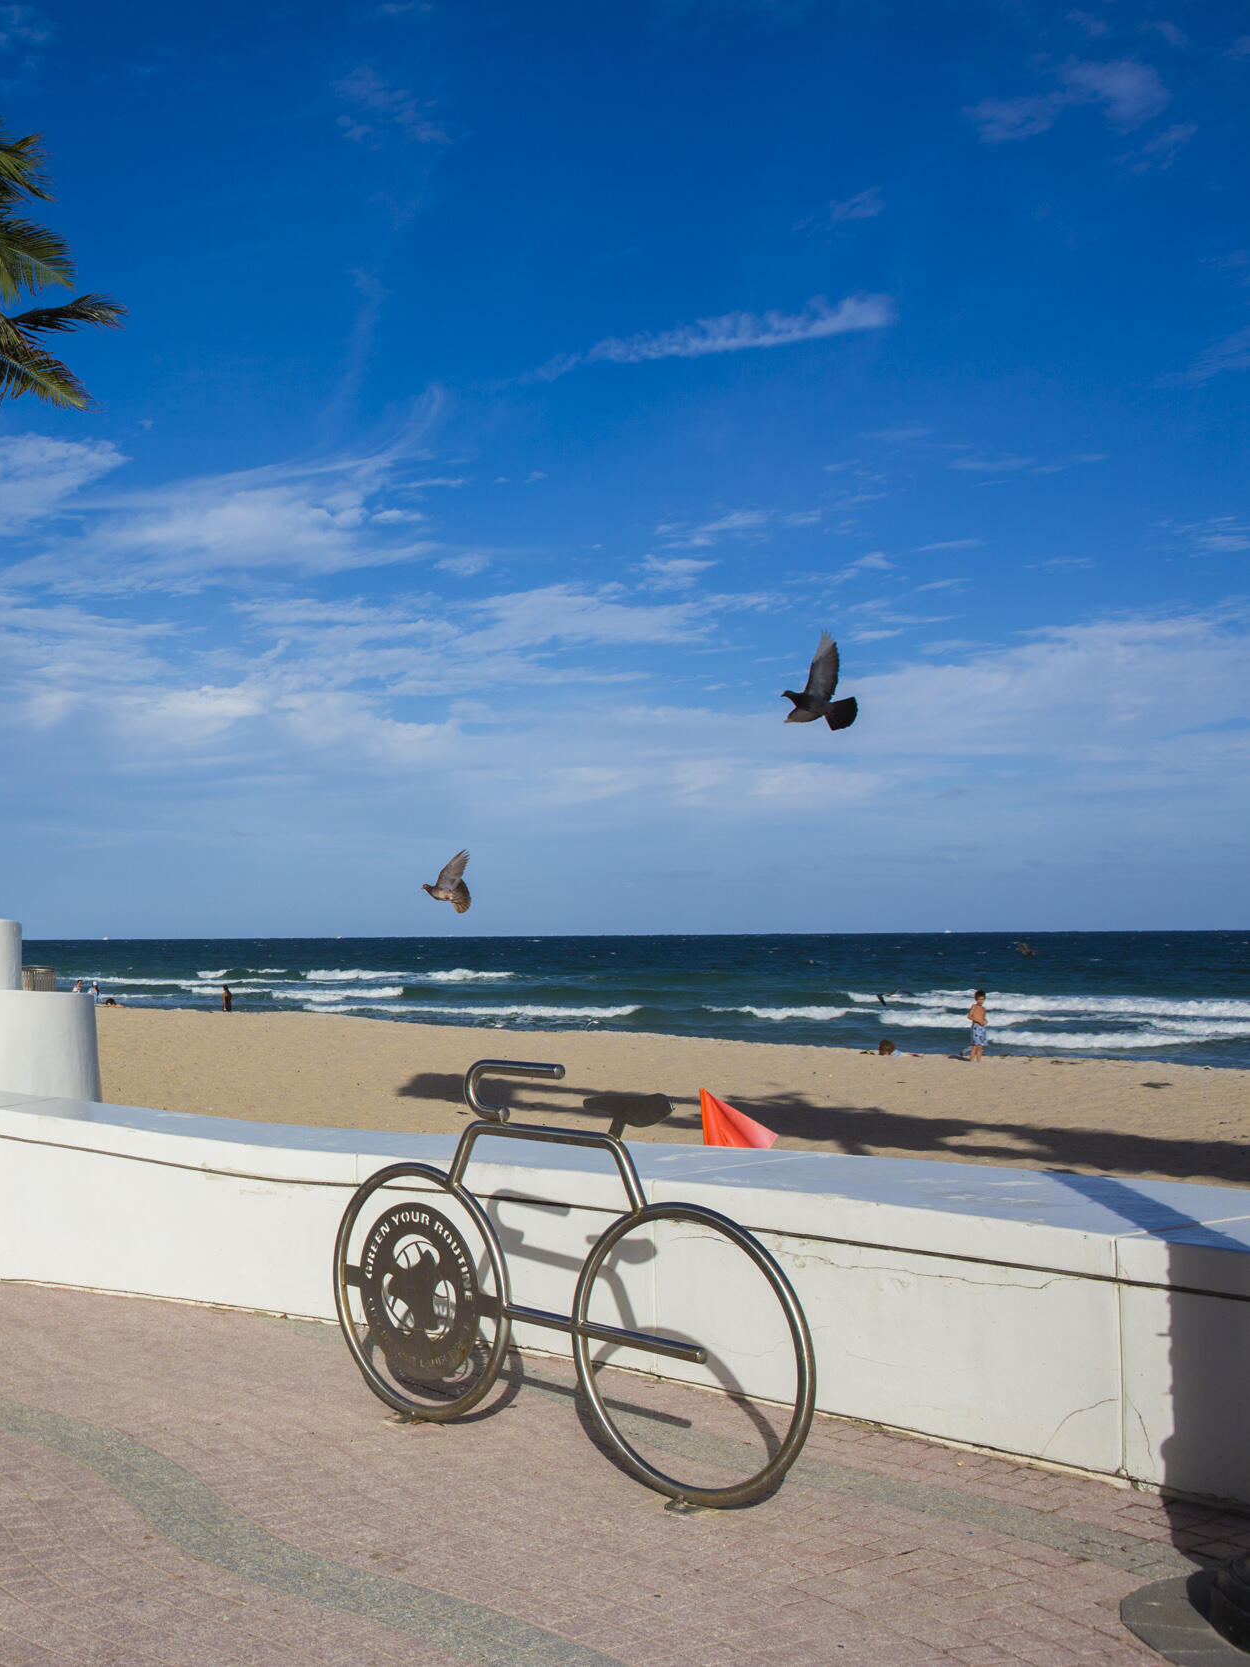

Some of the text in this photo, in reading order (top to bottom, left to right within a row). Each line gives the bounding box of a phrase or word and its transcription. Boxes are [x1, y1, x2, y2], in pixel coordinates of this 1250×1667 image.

[365, 1210, 473, 1301] GREEN YOUR ROUTINE
